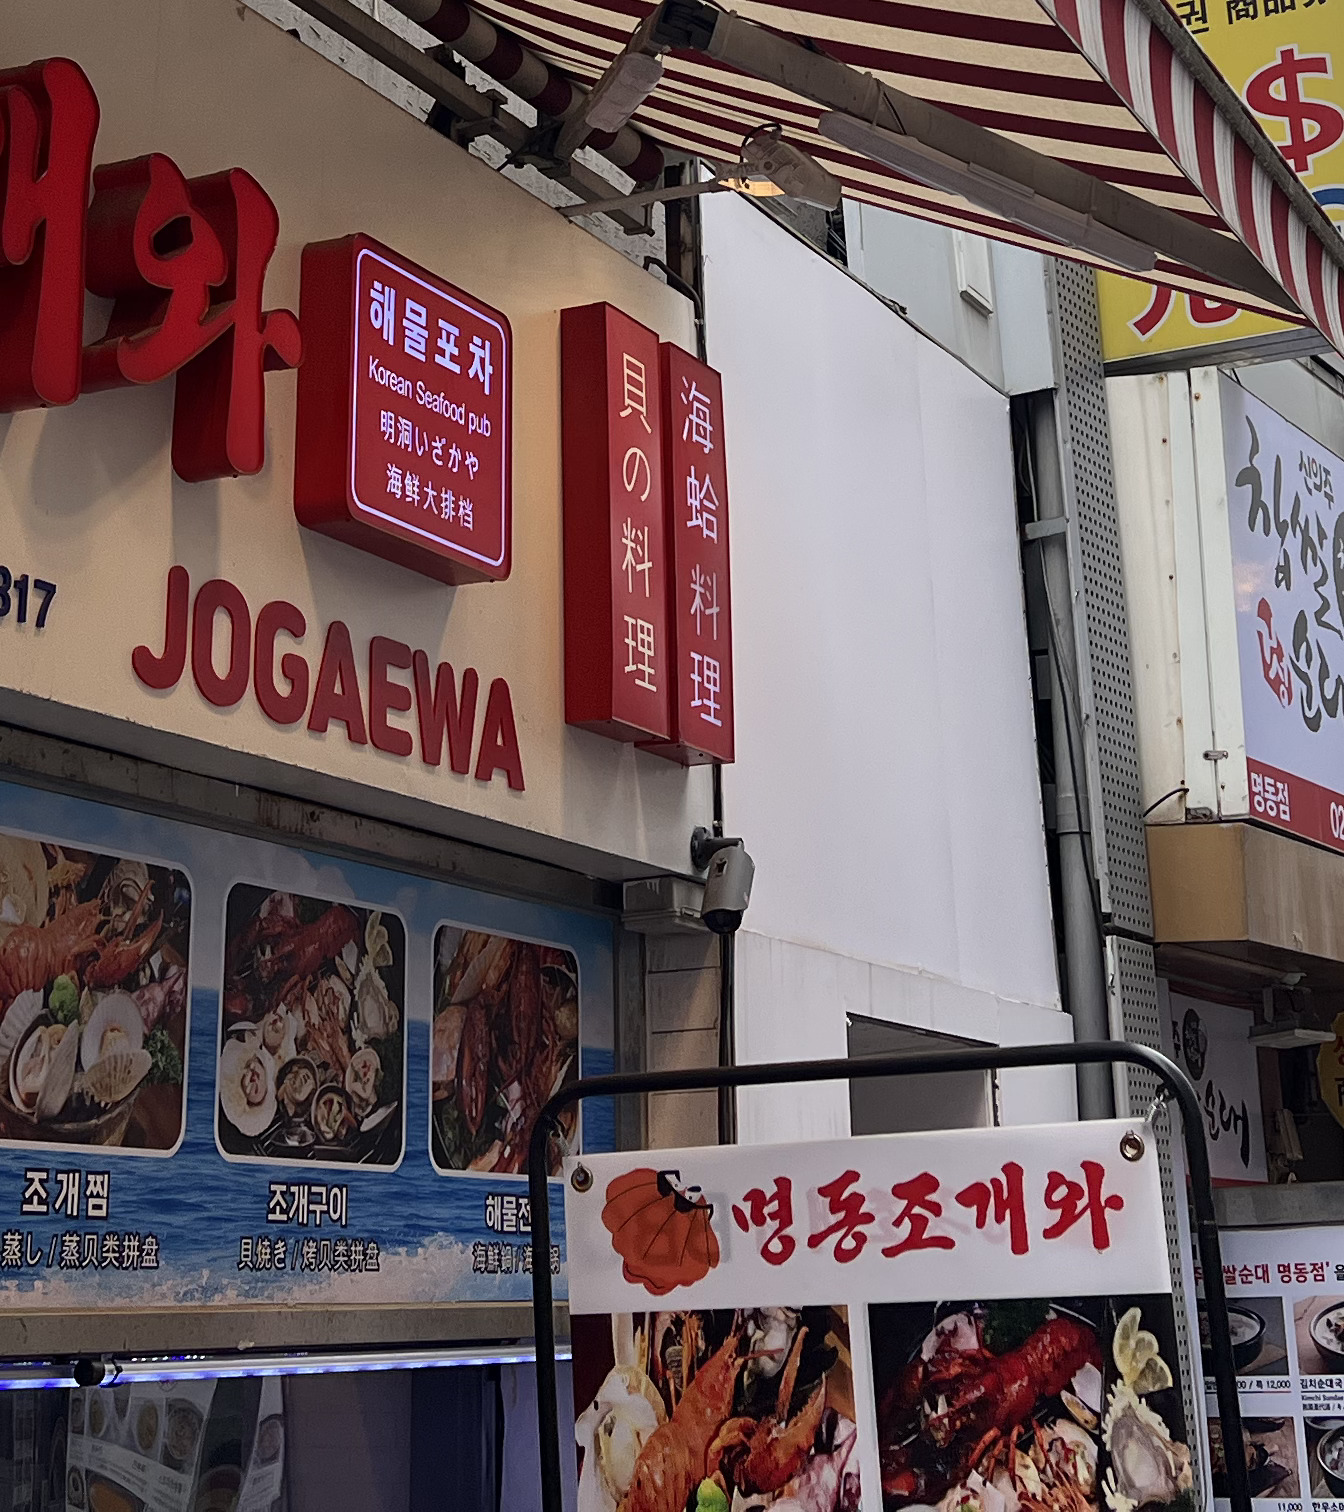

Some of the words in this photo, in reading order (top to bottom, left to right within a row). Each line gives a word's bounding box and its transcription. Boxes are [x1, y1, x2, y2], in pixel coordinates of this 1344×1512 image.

[368, 279, 495, 397] 해물포차
[367, 354, 413, 401] Korean
[415, 380, 465, 434] Seafood
[467, 405, 493, 439] pub
[378, 408, 480, 481] 明洞いざかや
[617, 352, 658, 694] 貝の料理
[679, 374, 724, 728] 海蛤料理
[131, 565, 526, 792] JOGAEWA
[1250, 770, 1291, 824] 명동점
[19, 1167, 112, 1220] 조개찜
[266, 1182, 349, 1226] 조개구이
[484, 1193, 532, 1234] 해물전
[730, 1159, 1126, 1267] 명동조개와
[60, 1232, 160, 1271] 蒸贝类拼盘
[300, 1239, 382, 1275] 烤贝类拼盘
[1223, 1263, 1270, 1286] 쌀순대
[1266, 1379, 1292, 1390] 12,000
[1299, 1378, 1344, 1390] 김치순대국
